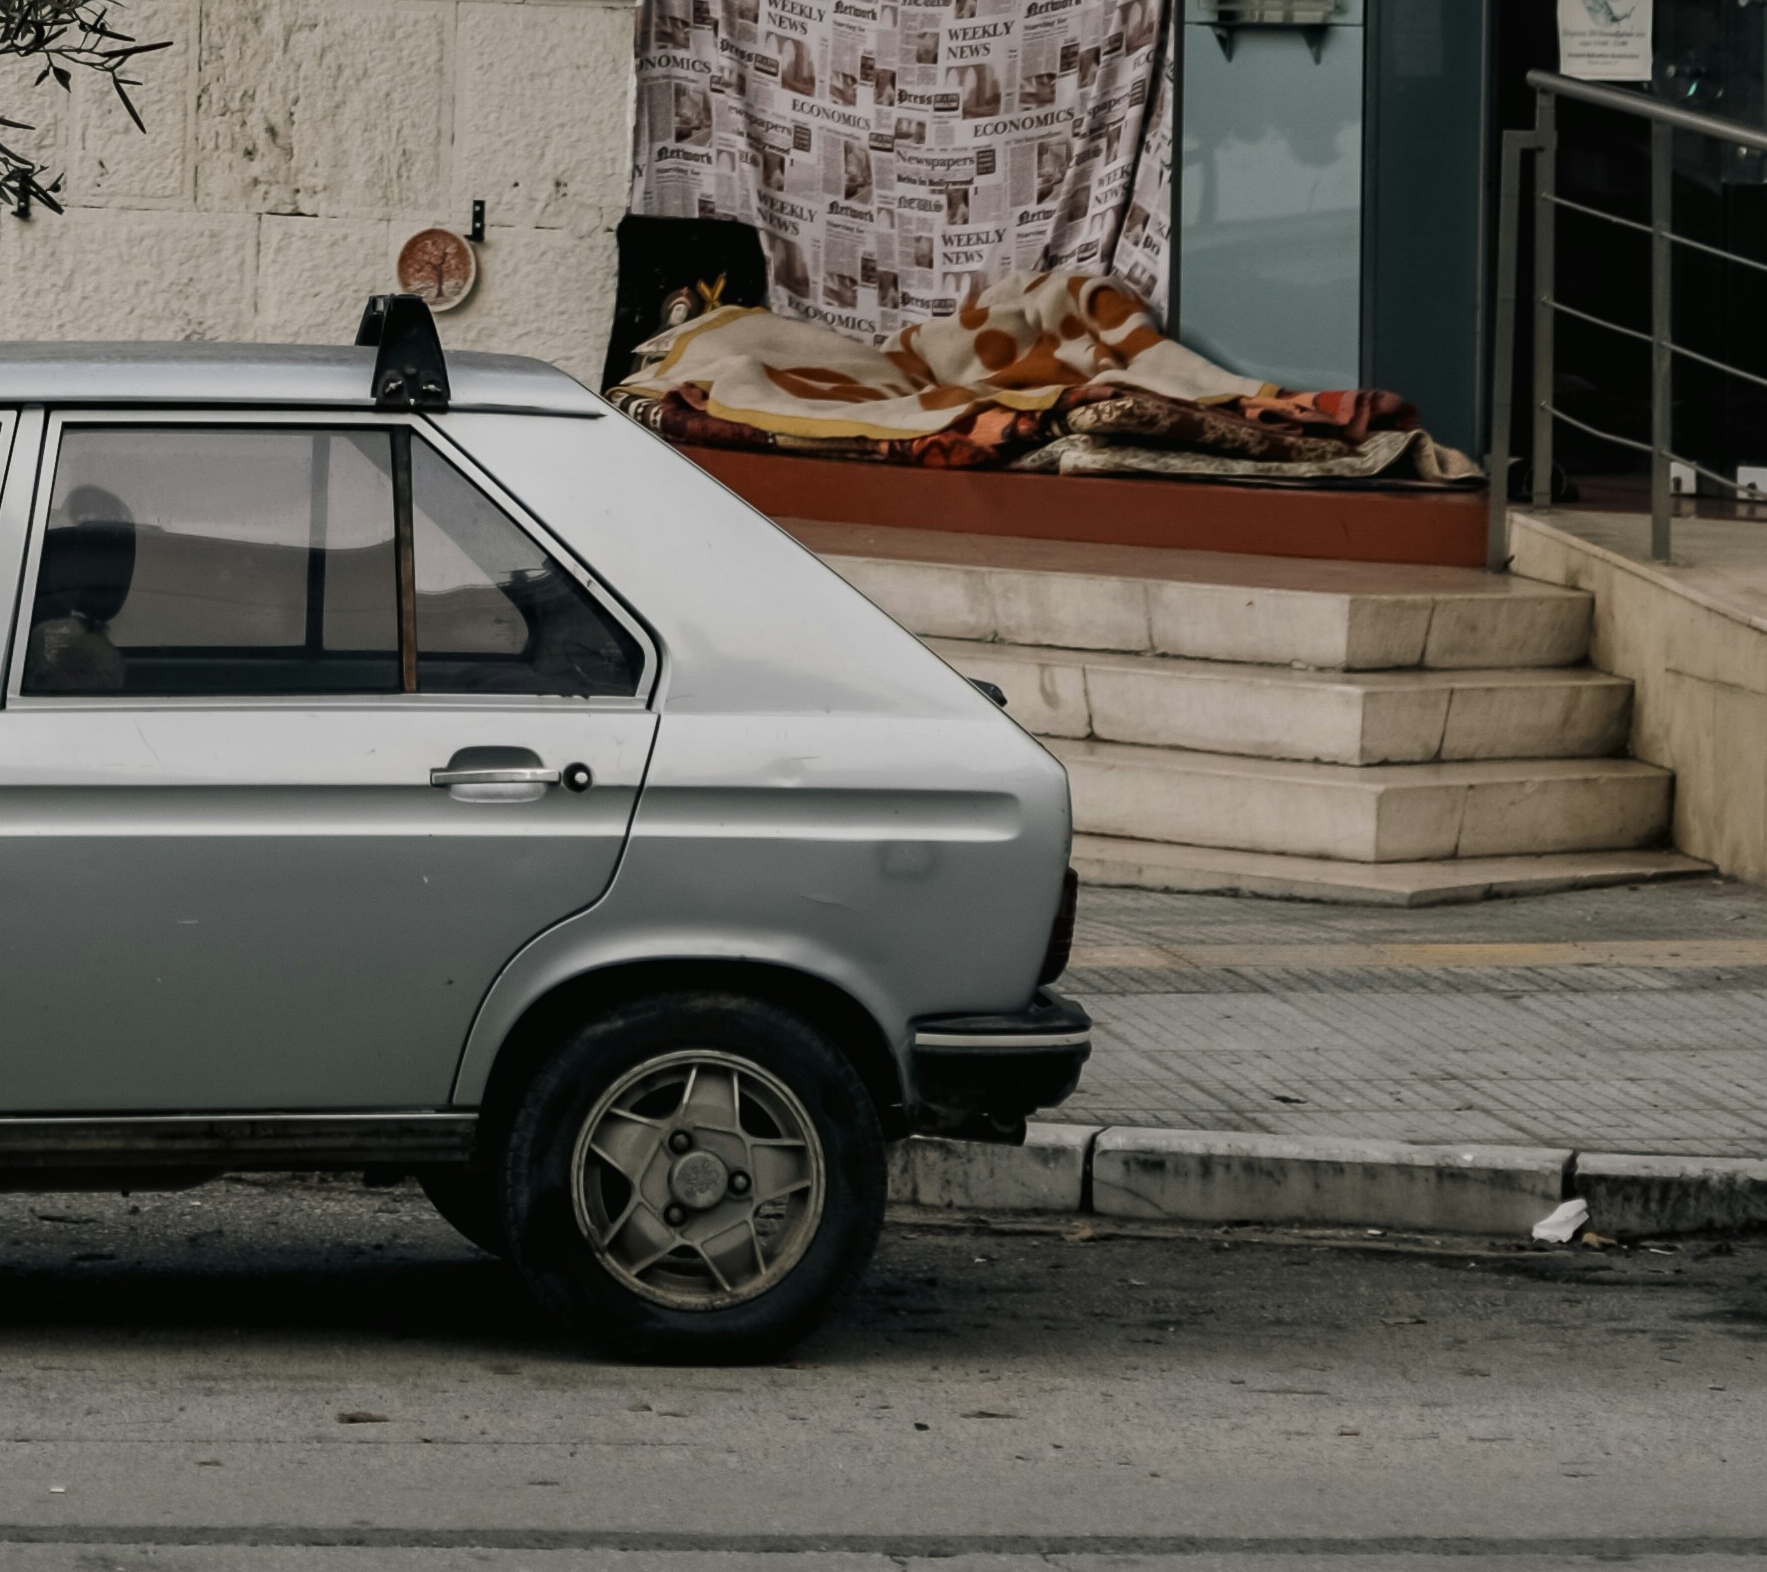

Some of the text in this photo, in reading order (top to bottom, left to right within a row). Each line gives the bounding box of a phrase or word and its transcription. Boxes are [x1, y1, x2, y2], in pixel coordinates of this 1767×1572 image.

[766, 11, 808, 35] NEWS
[948, 21, 1015, 41] WEEKLY
[947, 43, 991, 60] NEWS
[897, 89, 933, 105] Press
[792, 98, 871, 131] ECONOMICS
[974, 108, 1075, 138] ECONOMICS
[896, 150, 975, 170] Newspapers
[941, 229, 1007, 248] WEEKLY
[942, 250, 984, 265] NEWS
